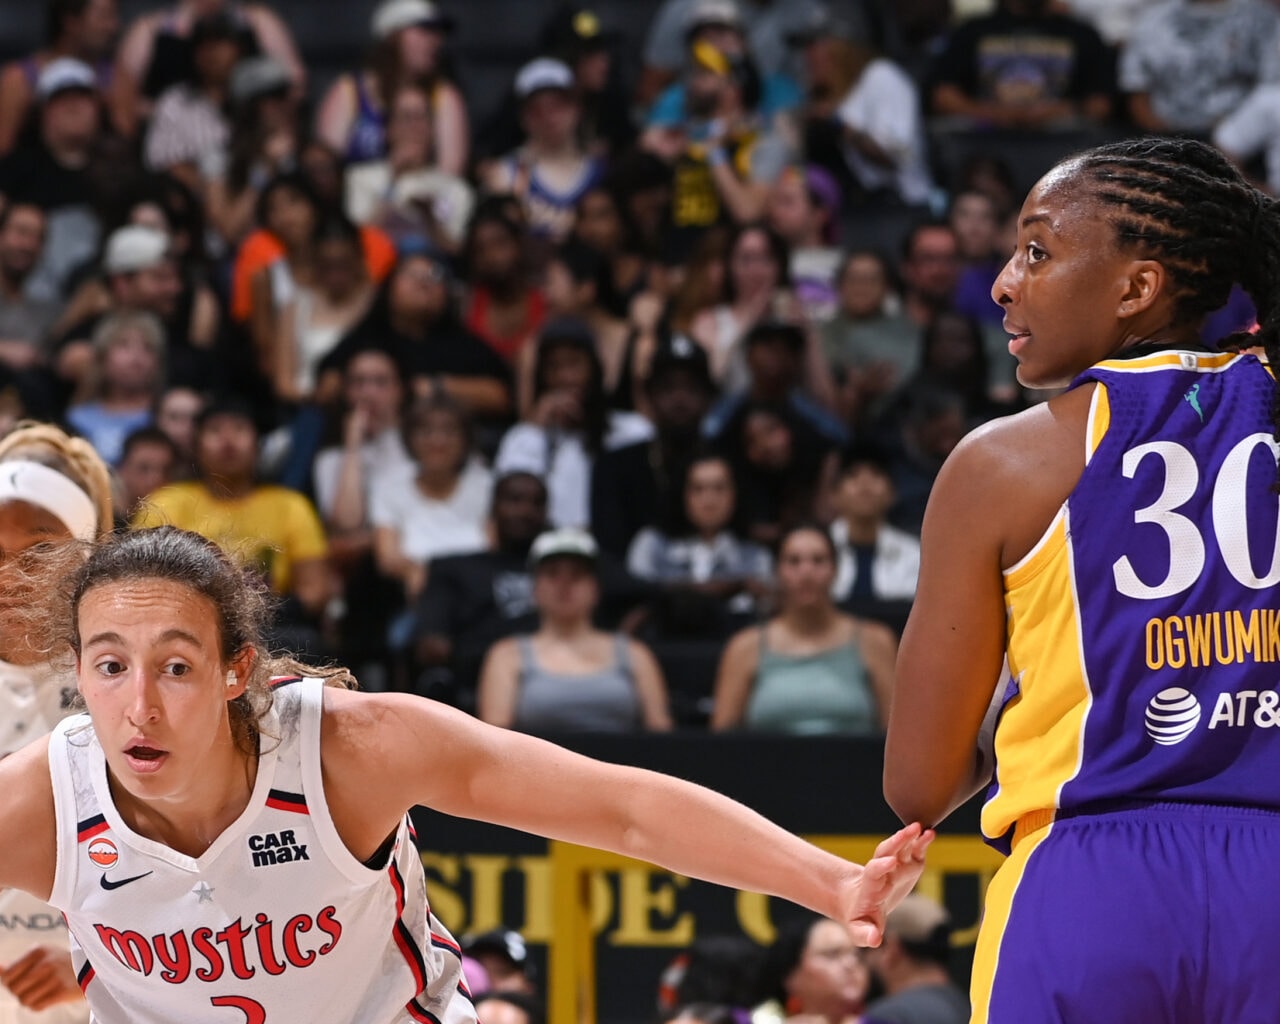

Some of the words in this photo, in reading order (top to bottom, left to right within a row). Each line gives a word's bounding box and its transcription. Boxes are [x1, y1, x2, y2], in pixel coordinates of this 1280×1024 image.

[1113, 432, 1280, 599] 30
[248, 829, 297, 851] CAR
[252, 844, 310, 867] max
